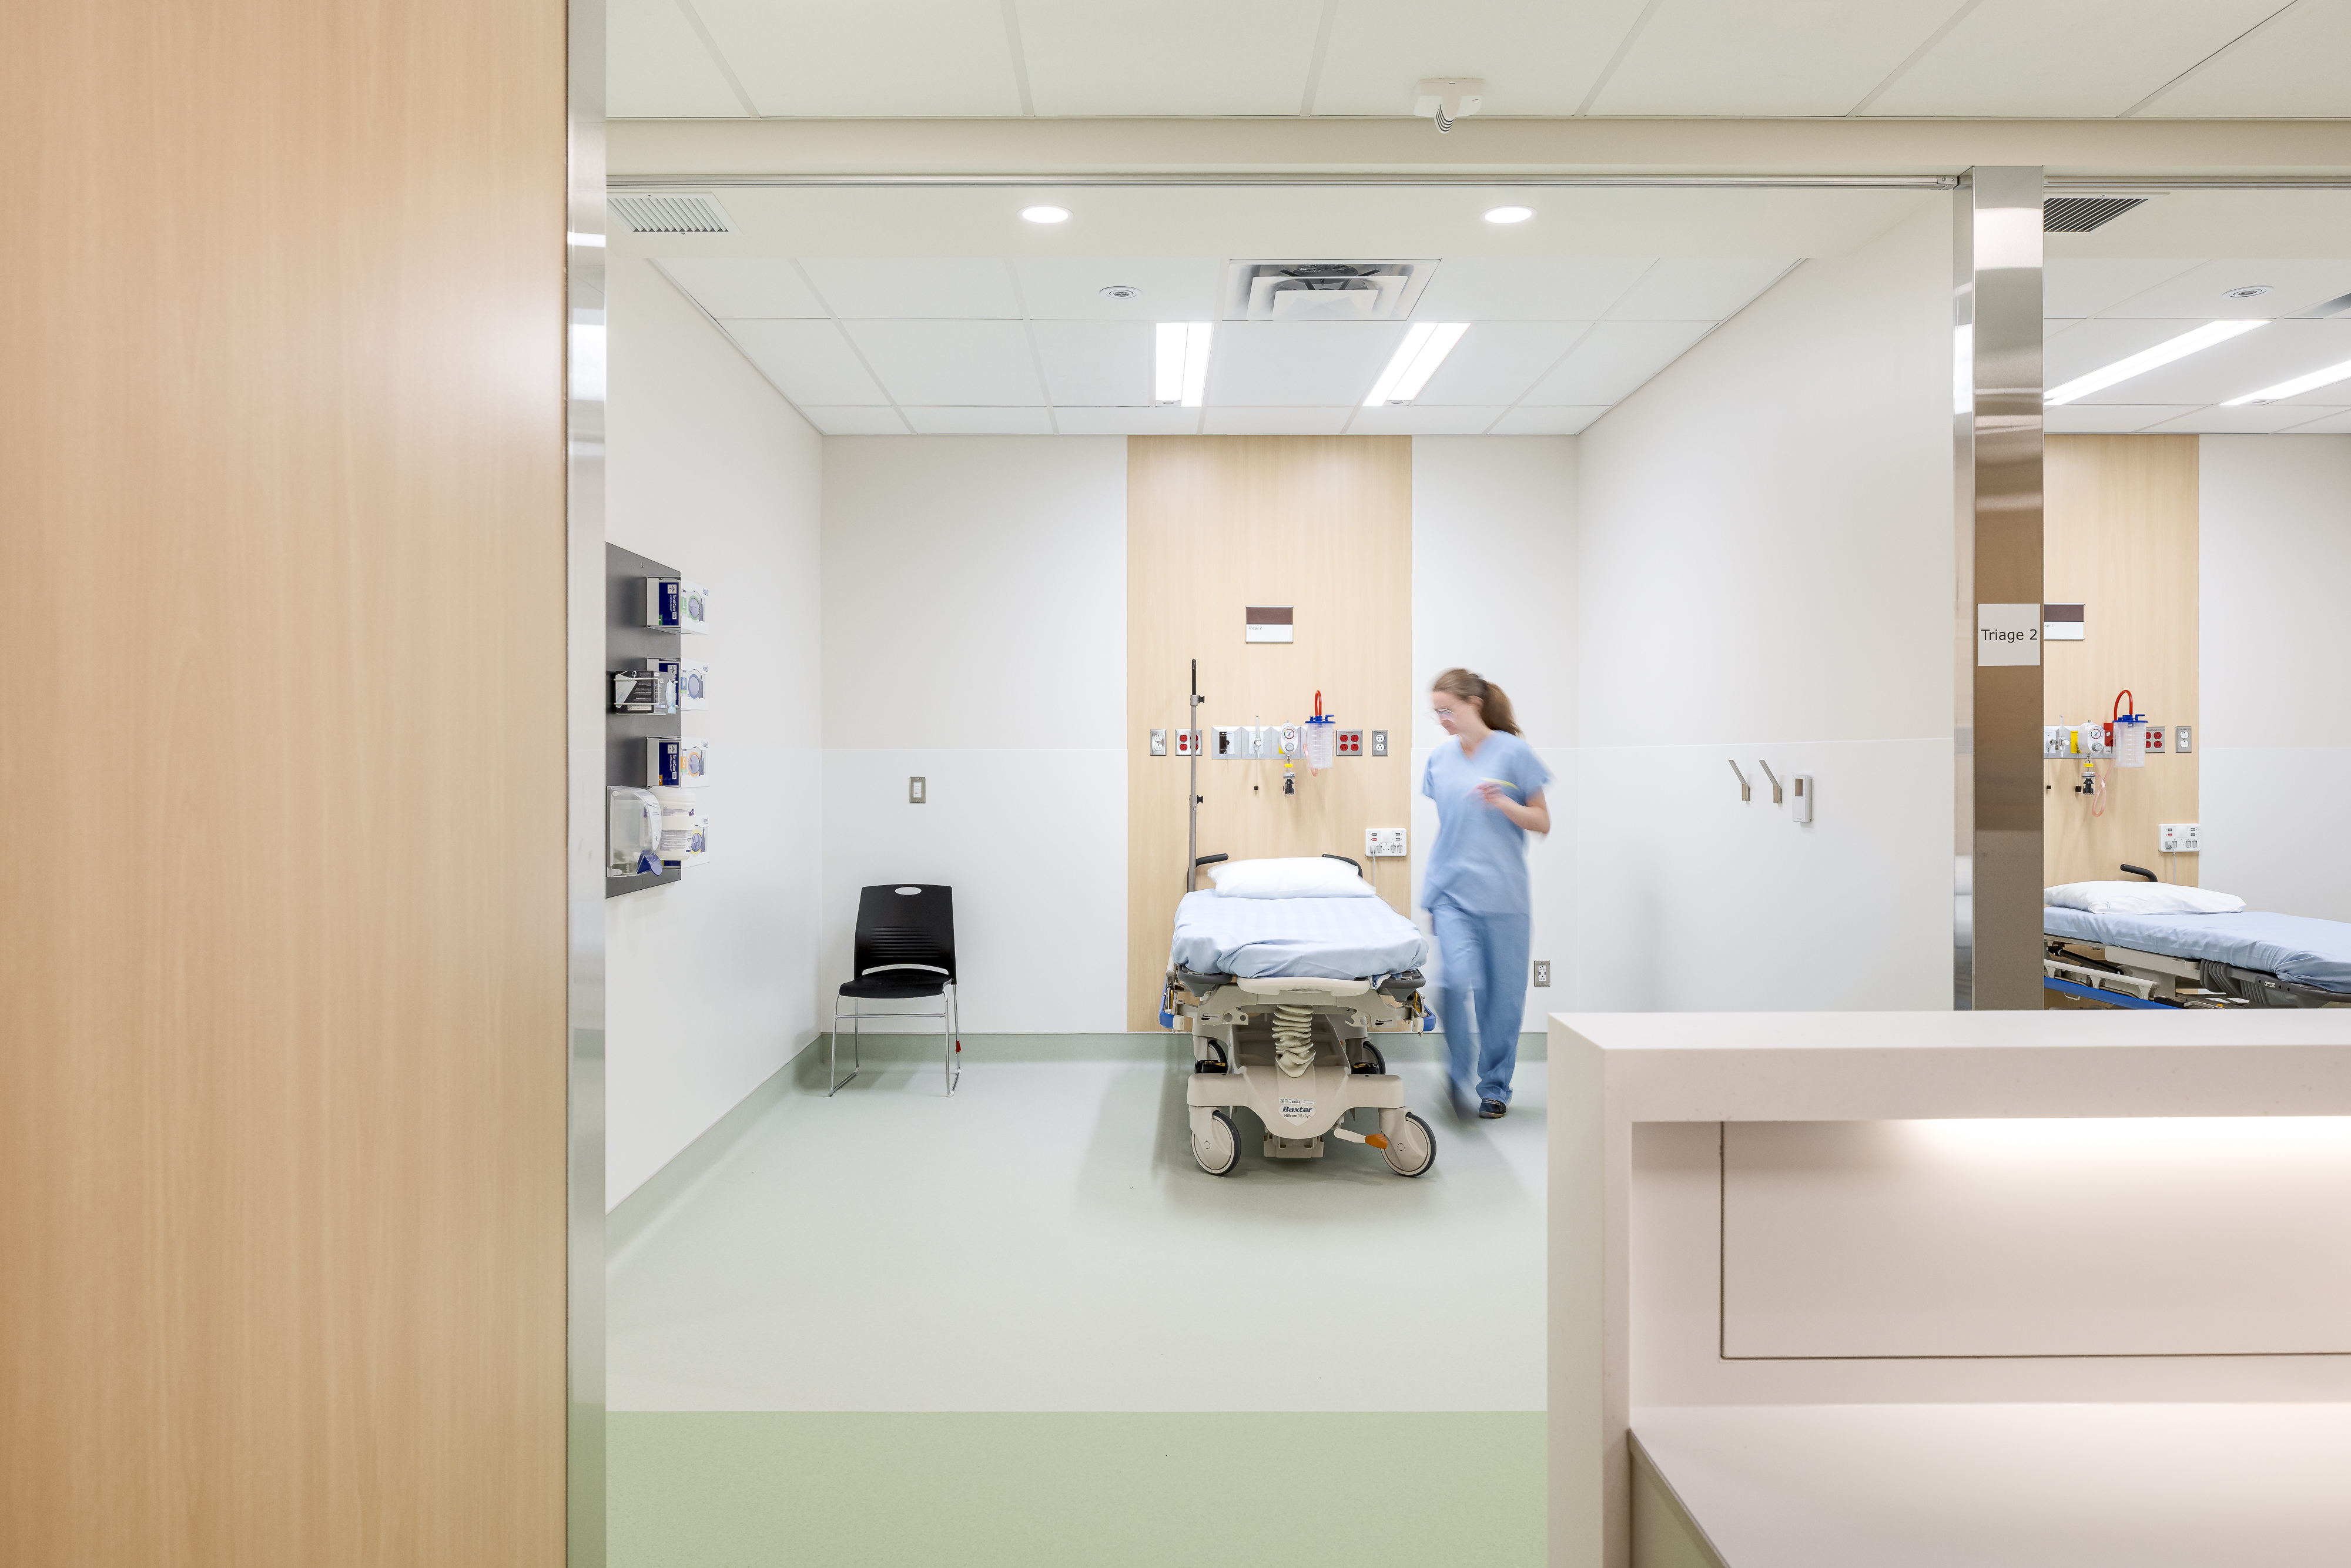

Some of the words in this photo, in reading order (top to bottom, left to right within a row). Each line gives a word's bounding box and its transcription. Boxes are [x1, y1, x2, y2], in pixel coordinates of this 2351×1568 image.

[1981, 629, 2024, 644] Triage
[2030, 629, 2038, 640] 2
[682, 679, 686, 689] M
[682, 758, 686, 768] S
